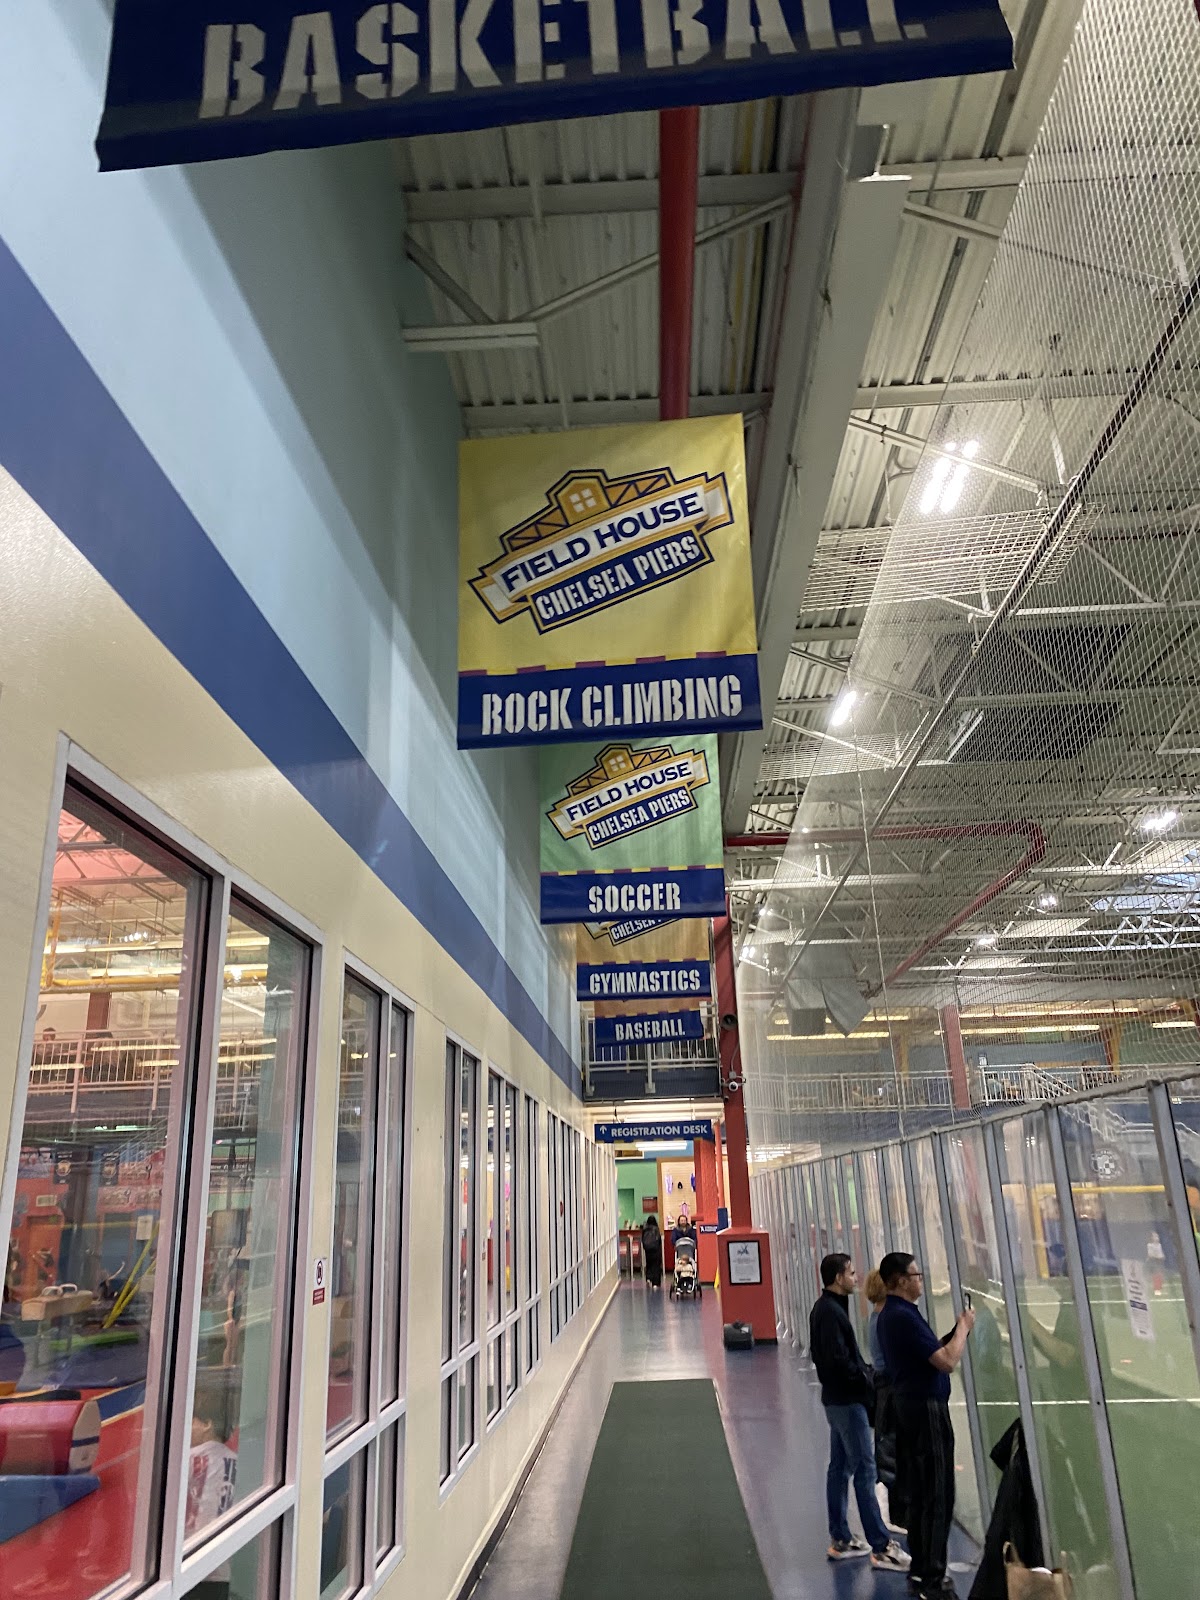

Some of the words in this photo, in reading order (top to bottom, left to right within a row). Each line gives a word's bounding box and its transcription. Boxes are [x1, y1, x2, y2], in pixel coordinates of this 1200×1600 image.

[501, 536, 591, 594] FIELD
[597, 492, 704, 550] HOUSE
[535, 564, 635, 620] CHELSEA
[639, 535, 700, 581] PIERS
[481, 687, 573, 736] ROCK
[581, 674, 742, 728] CLIMBING
[565, 787, 622, 822] FIELD
[625, 761, 692, 796] HOUSE
[588, 806, 649, 842] CHELSEA
[648, 789, 691, 818] PIERS
[588, 882, 681, 914] SOCCER
[589, 969, 700, 995] GYMNASTICS
[615, 1018, 686, 1041] BASEBALL
[611, 1125, 680, 1137] REGISTRATION
[683, 1124, 708, 1134] DESK
